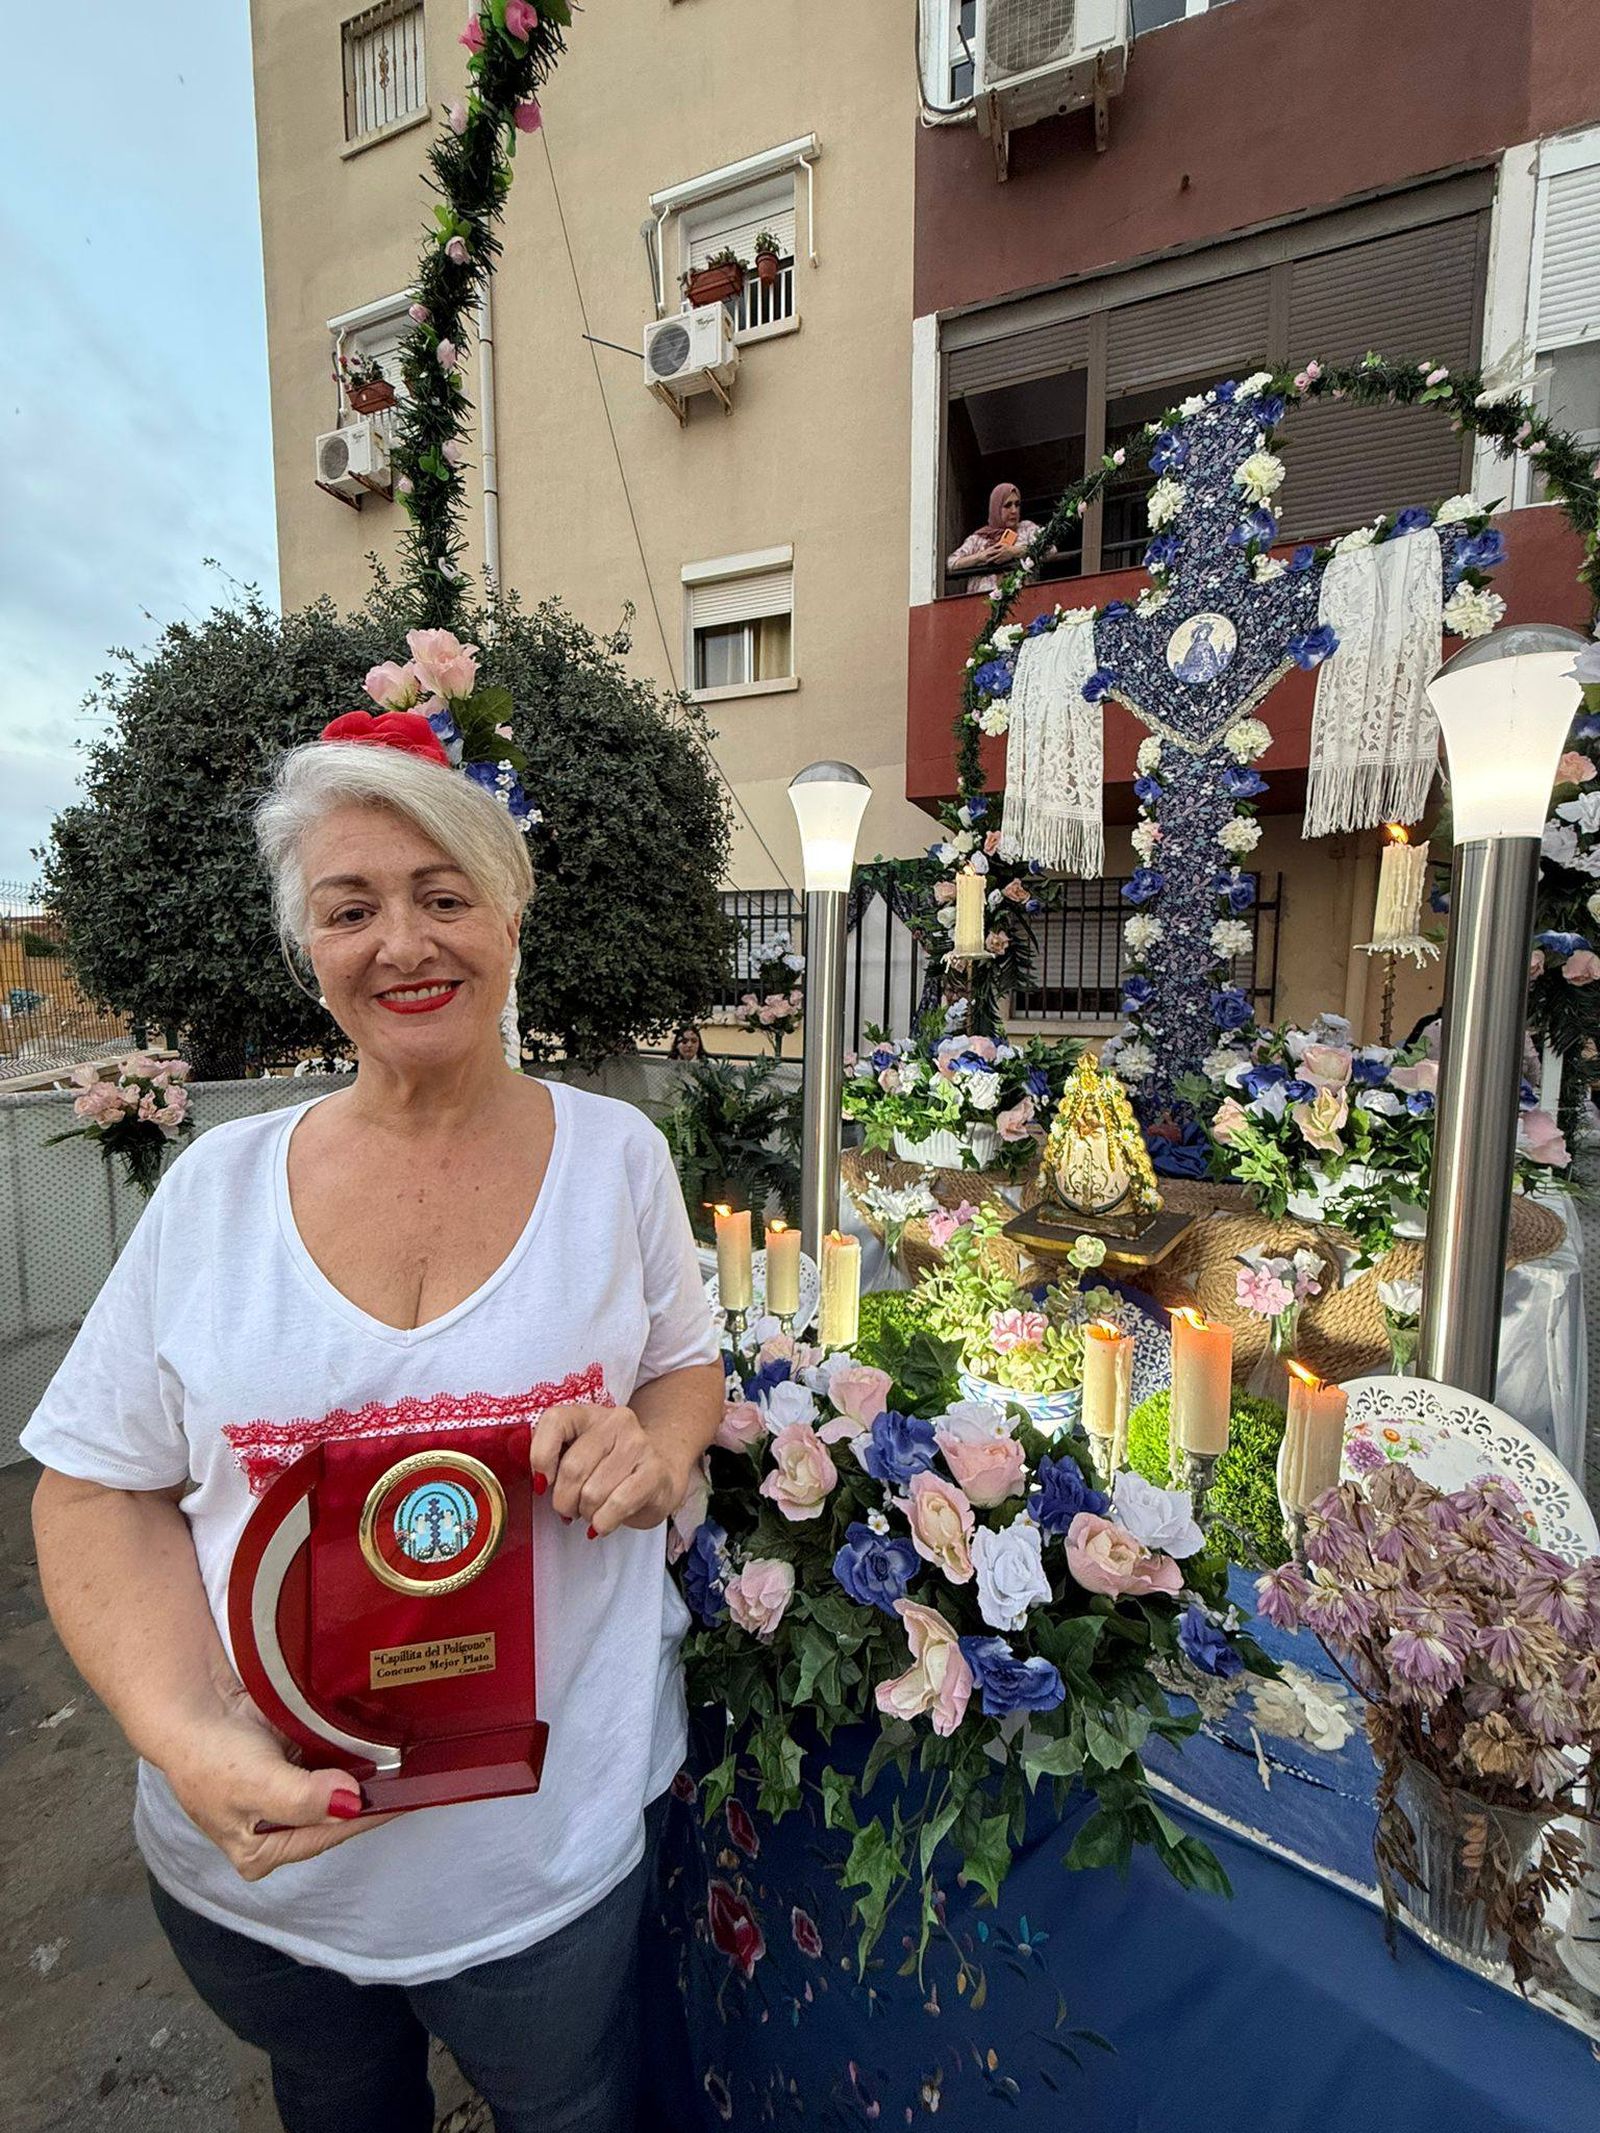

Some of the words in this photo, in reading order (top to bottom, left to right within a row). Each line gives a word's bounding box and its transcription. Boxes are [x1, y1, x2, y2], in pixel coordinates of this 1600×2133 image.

[425, 1646, 440, 1658] del
[377, 1665, 426, 1678] Concurso
[429, 1659, 460, 1670] Mejor
[463, 1654, 489, 1664] Plato
